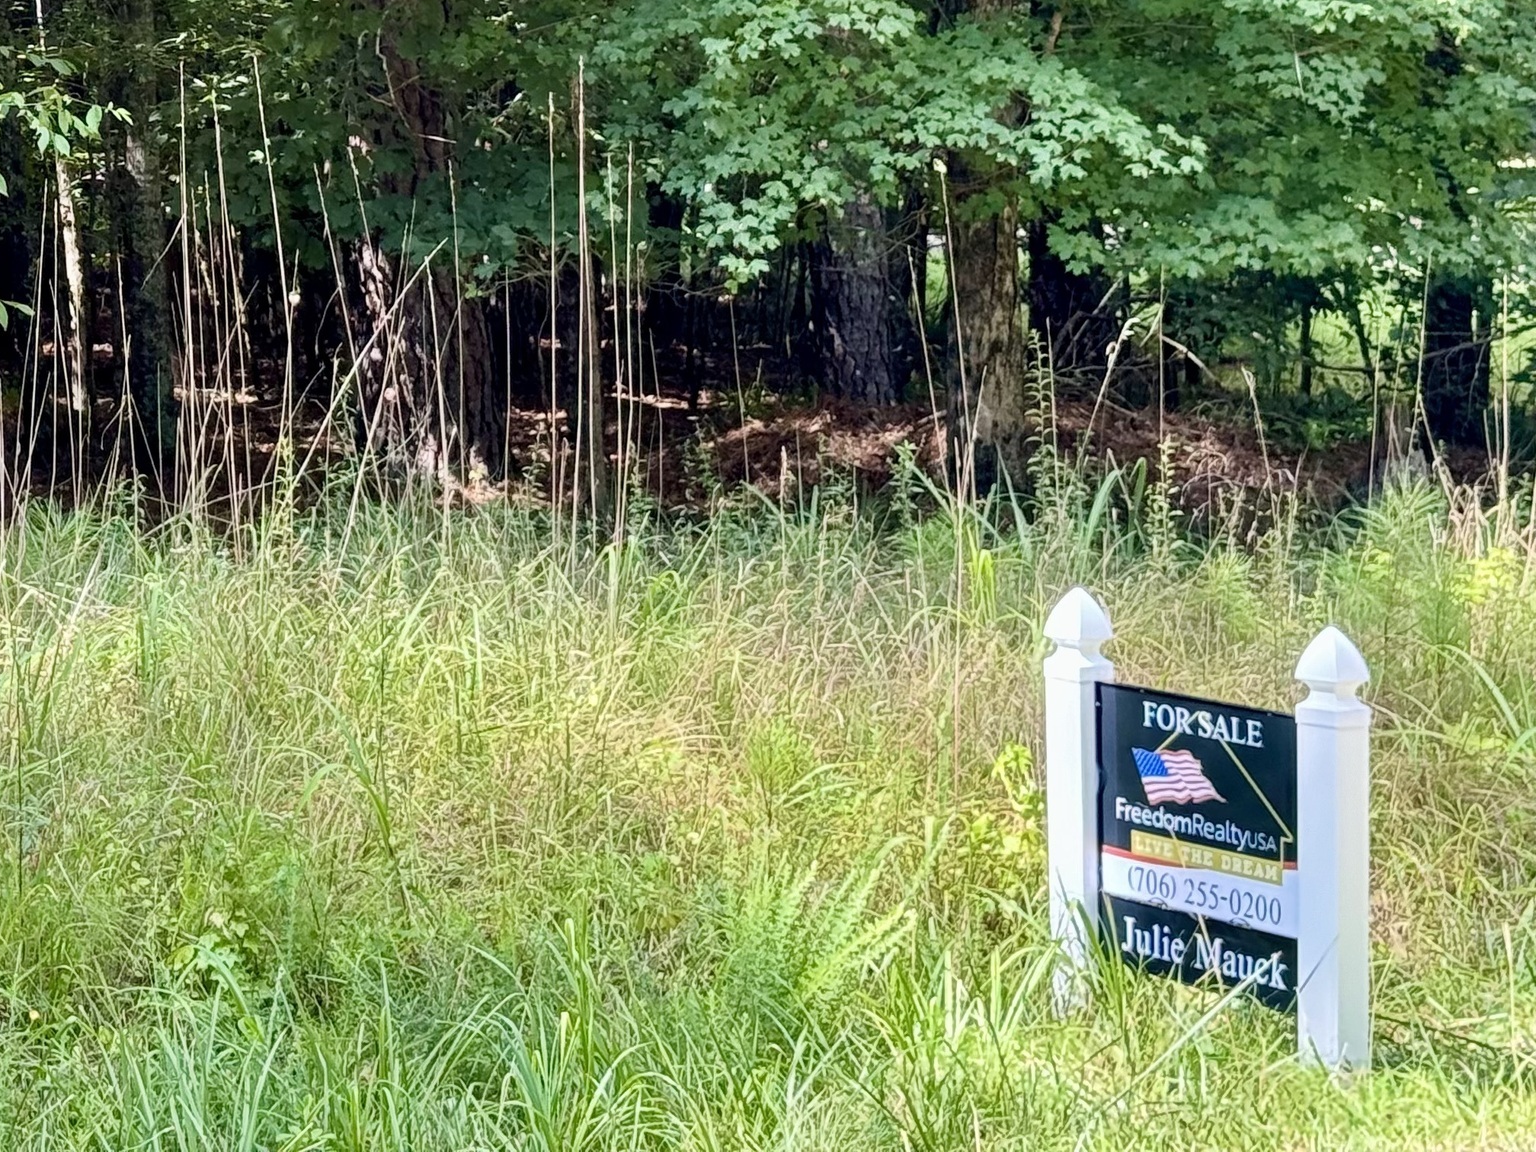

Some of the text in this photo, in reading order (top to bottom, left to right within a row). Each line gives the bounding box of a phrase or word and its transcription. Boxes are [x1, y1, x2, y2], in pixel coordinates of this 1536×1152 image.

[1143, 701, 1264, 748] FOR SALE
[1133, 836, 1278, 881] LIVE THE DREAM
[1128, 866, 1282, 926] (706) 255-0200
[1121, 915, 1289, 991] Julie Mauck
